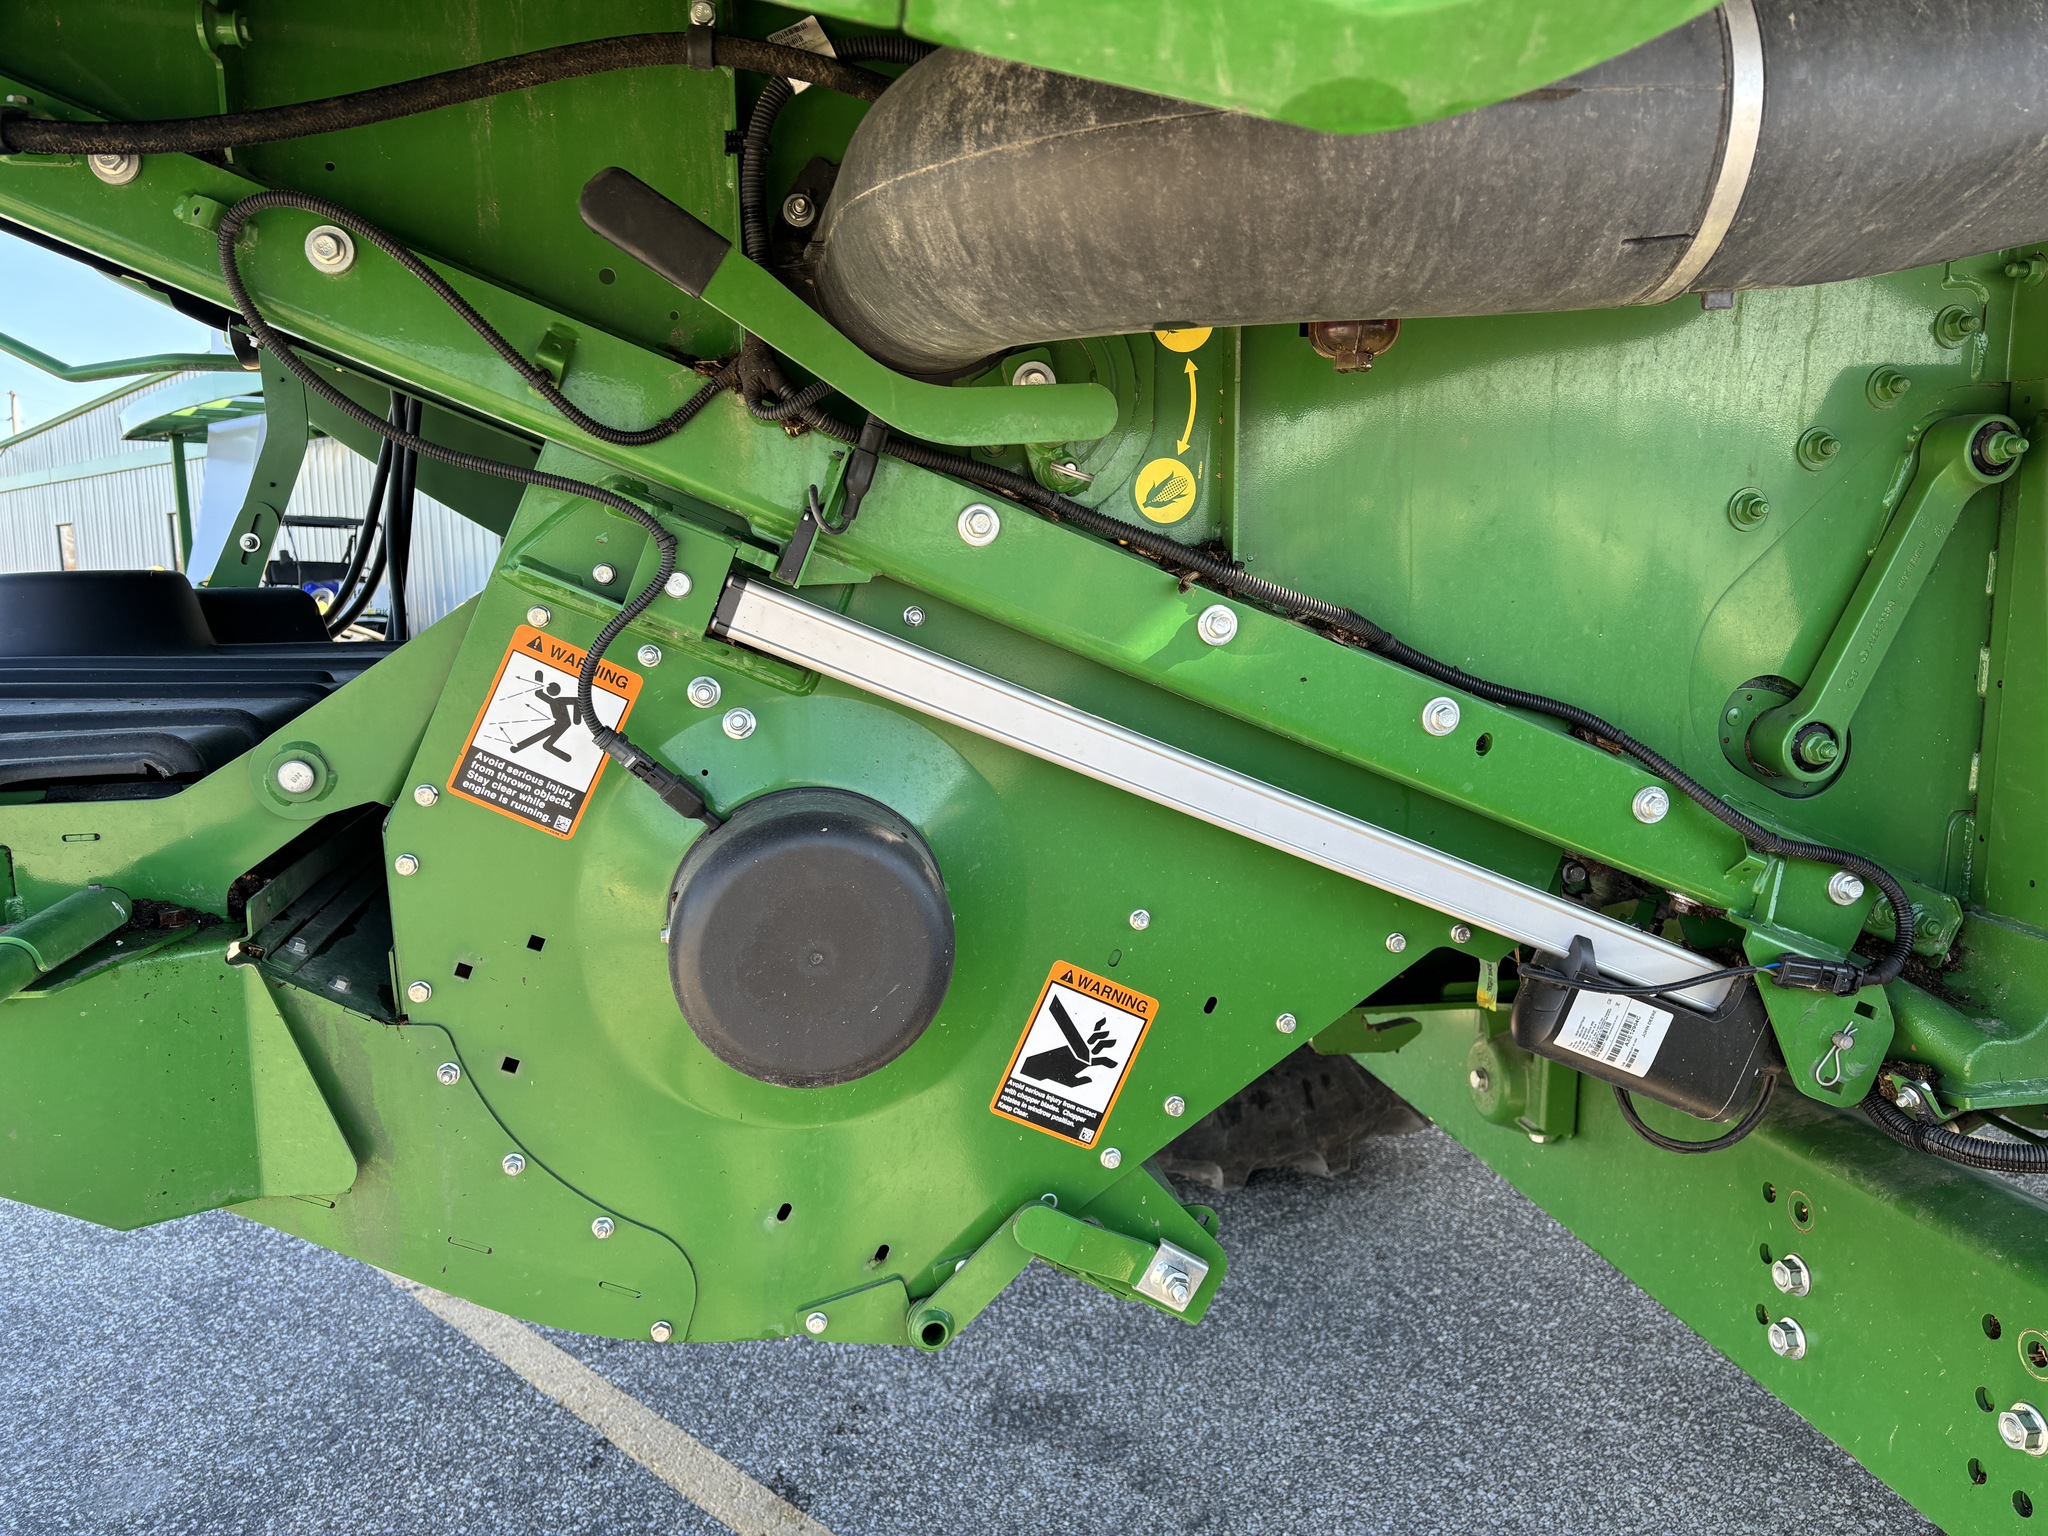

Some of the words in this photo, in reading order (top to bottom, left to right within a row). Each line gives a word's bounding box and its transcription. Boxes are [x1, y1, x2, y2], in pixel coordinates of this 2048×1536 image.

[465, 770, 491, 788] Stay
[490, 780, 517, 797] clear
[518, 792, 547, 810] while
[470, 760, 496, 777] from
[496, 771, 533, 793] thrown
[532, 786, 575, 811] objects.
[474, 750, 506, 770] Avoid
[506, 764, 545, 787] serious
[544, 780, 577, 801] injury
[461, 779, 498, 802] engine
[498, 794, 509, 805] is
[508, 799, 553, 825] running.
[1078, 974, 1148, 1013] WARNING
[1640, 1024, 1651, 1039] JOHN
[1646, 1009, 1658, 1026] DEERE
[996, 1100, 1013, 1113] Keep
[1012, 1106, 1030, 1119] Clear.
[1000, 1093, 1022, 1107] rotates
[1020, 1101, 1028, 1109] in
[1027, 1104, 1052, 1119] windrow
[1050, 1113, 1076, 1130] position.
[1004, 1086, 1018, 1096] with
[1016, 1091, 1041, 1107] chopper
[1040, 1100, 1061, 1114] blades.
[1061, 1109, 1087, 1125] Chopper
[1007, 1078, 1026, 1090] Avoid
[1024, 1085, 1046, 1099] serious
[1044, 1093, 1063, 1107] injury
[1062, 1100, 1077, 1111] from
[1075, 1105, 1098, 1119] contact
